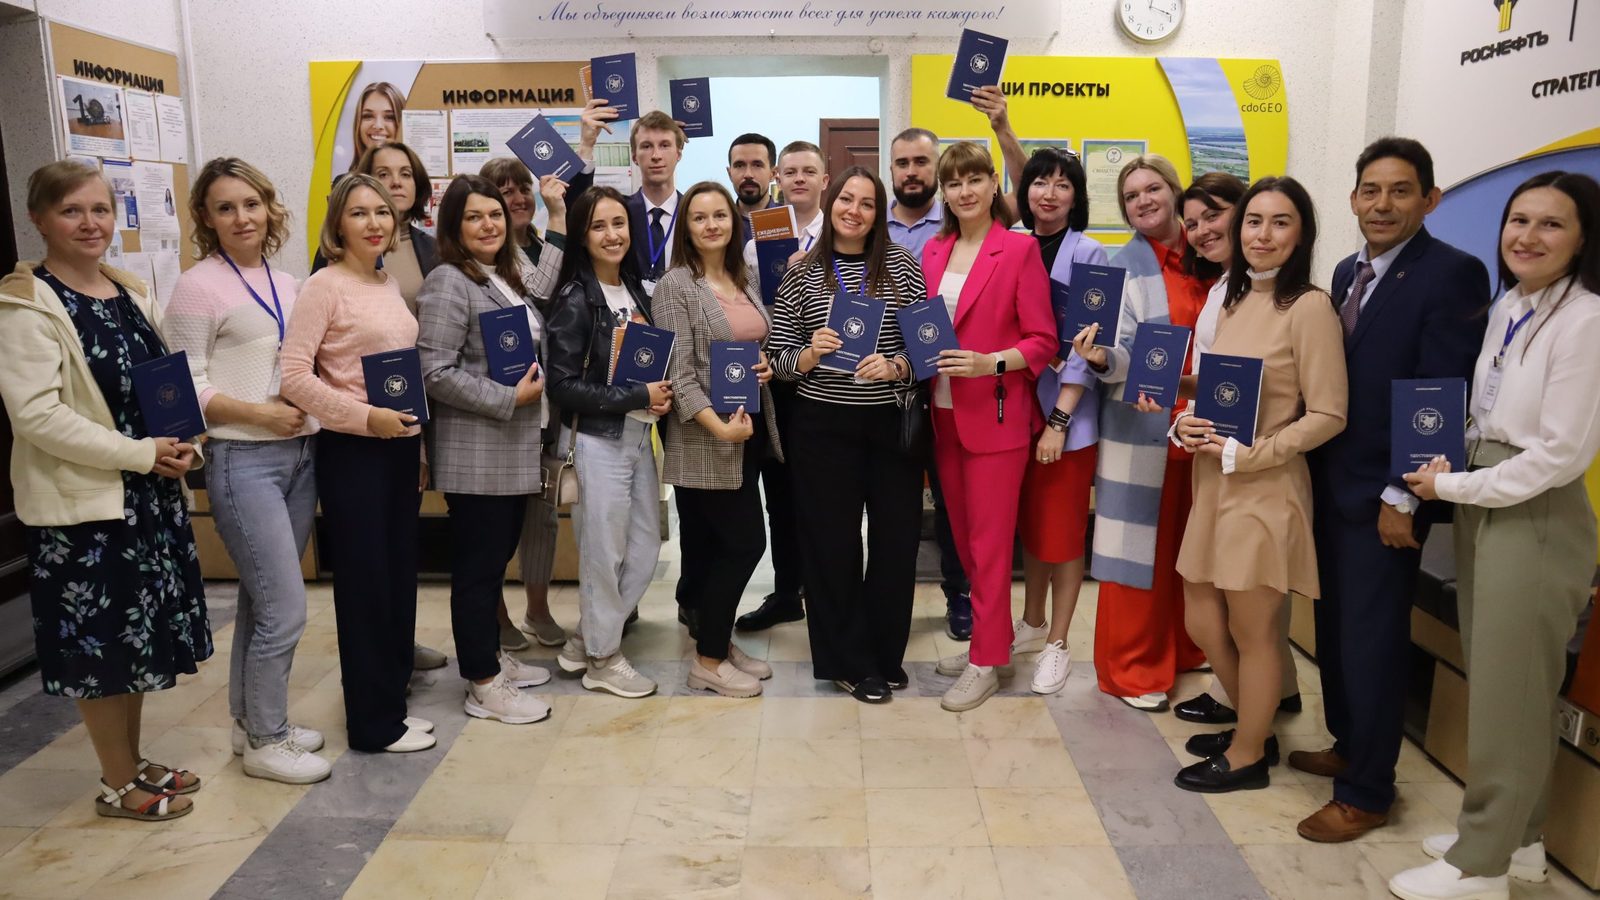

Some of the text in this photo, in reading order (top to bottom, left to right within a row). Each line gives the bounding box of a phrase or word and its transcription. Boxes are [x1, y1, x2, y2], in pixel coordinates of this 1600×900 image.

[538, 1, 1005, 28] Мы объединяем возможности всех для успеха каждого!
[1146, 25, 1153, 35] 6
[1460, 30, 1549, 66] РОСНЕФТЬ
[73, 59, 165, 94] ИНФОРМАЦИЯ
[442, 88, 575, 105] ИНФОРМАЦИЯ
[1029, 82, 1110, 97] ПРОЕКТЫ
[1241, 102, 1283, 113] cdoGEO
[756, 226, 790, 236] ЕЖЕДНЕВНИК
